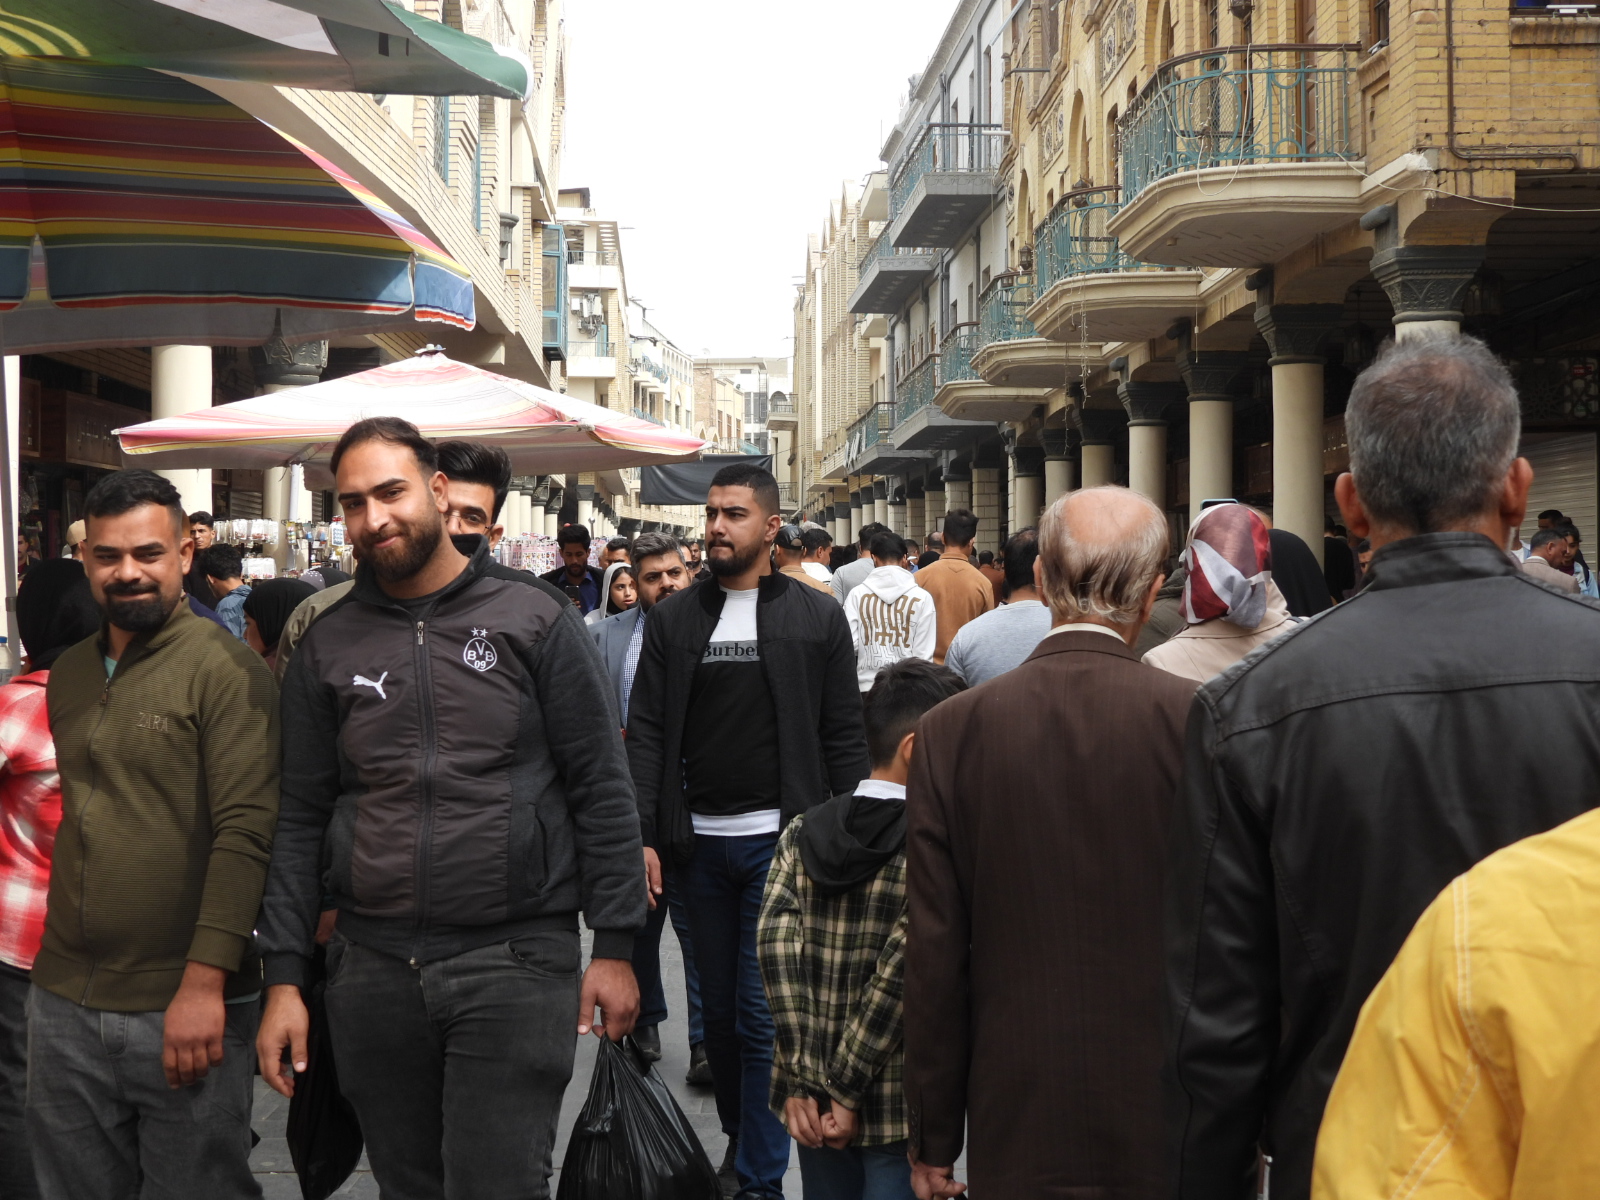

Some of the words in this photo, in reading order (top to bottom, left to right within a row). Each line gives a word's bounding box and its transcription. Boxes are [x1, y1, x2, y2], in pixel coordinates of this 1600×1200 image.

[466, 641, 495, 663] BVB
[474, 660, 487, 669] 09
[136, 711, 169, 732] ZARA
